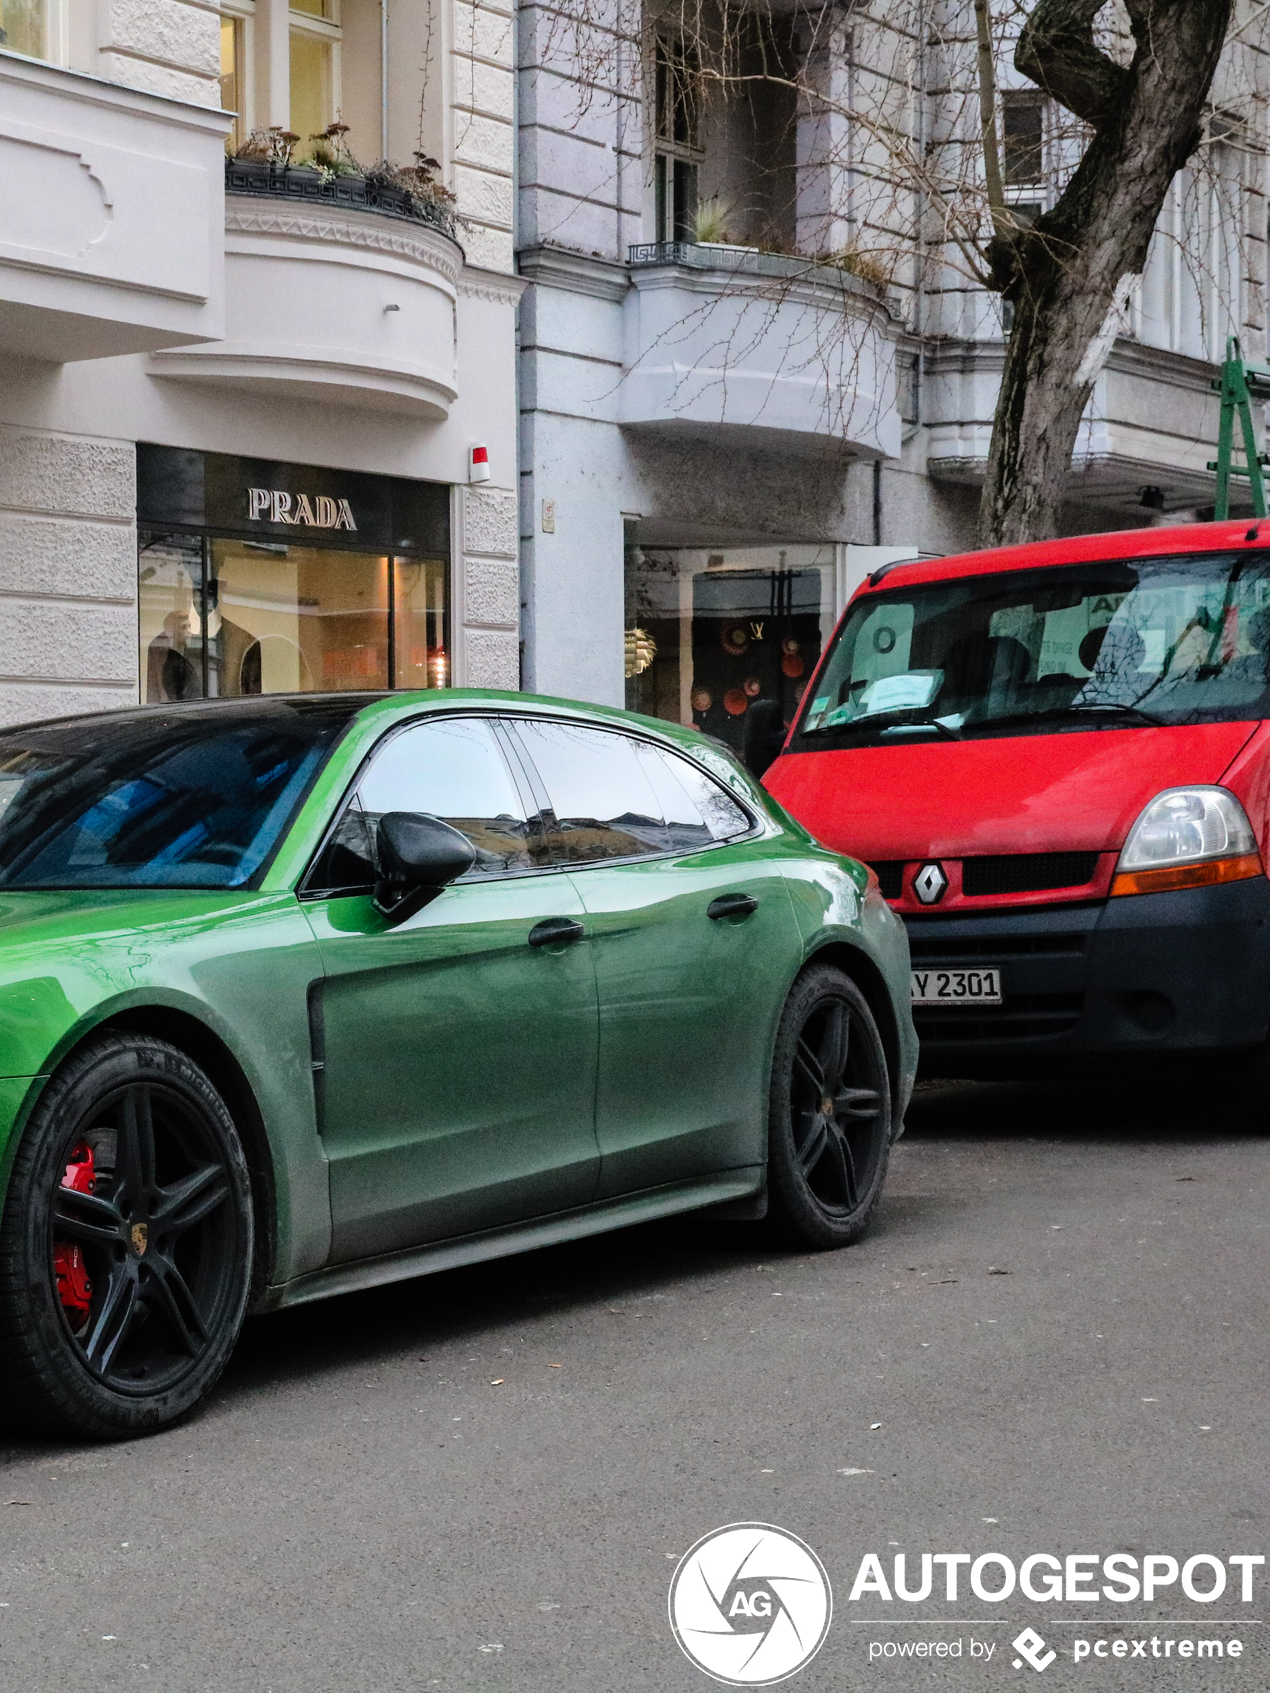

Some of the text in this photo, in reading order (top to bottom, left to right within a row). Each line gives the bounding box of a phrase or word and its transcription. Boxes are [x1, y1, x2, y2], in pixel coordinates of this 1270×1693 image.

[247, 487, 358, 531] PRADA
[911, 972, 999, 997] Y 2301
